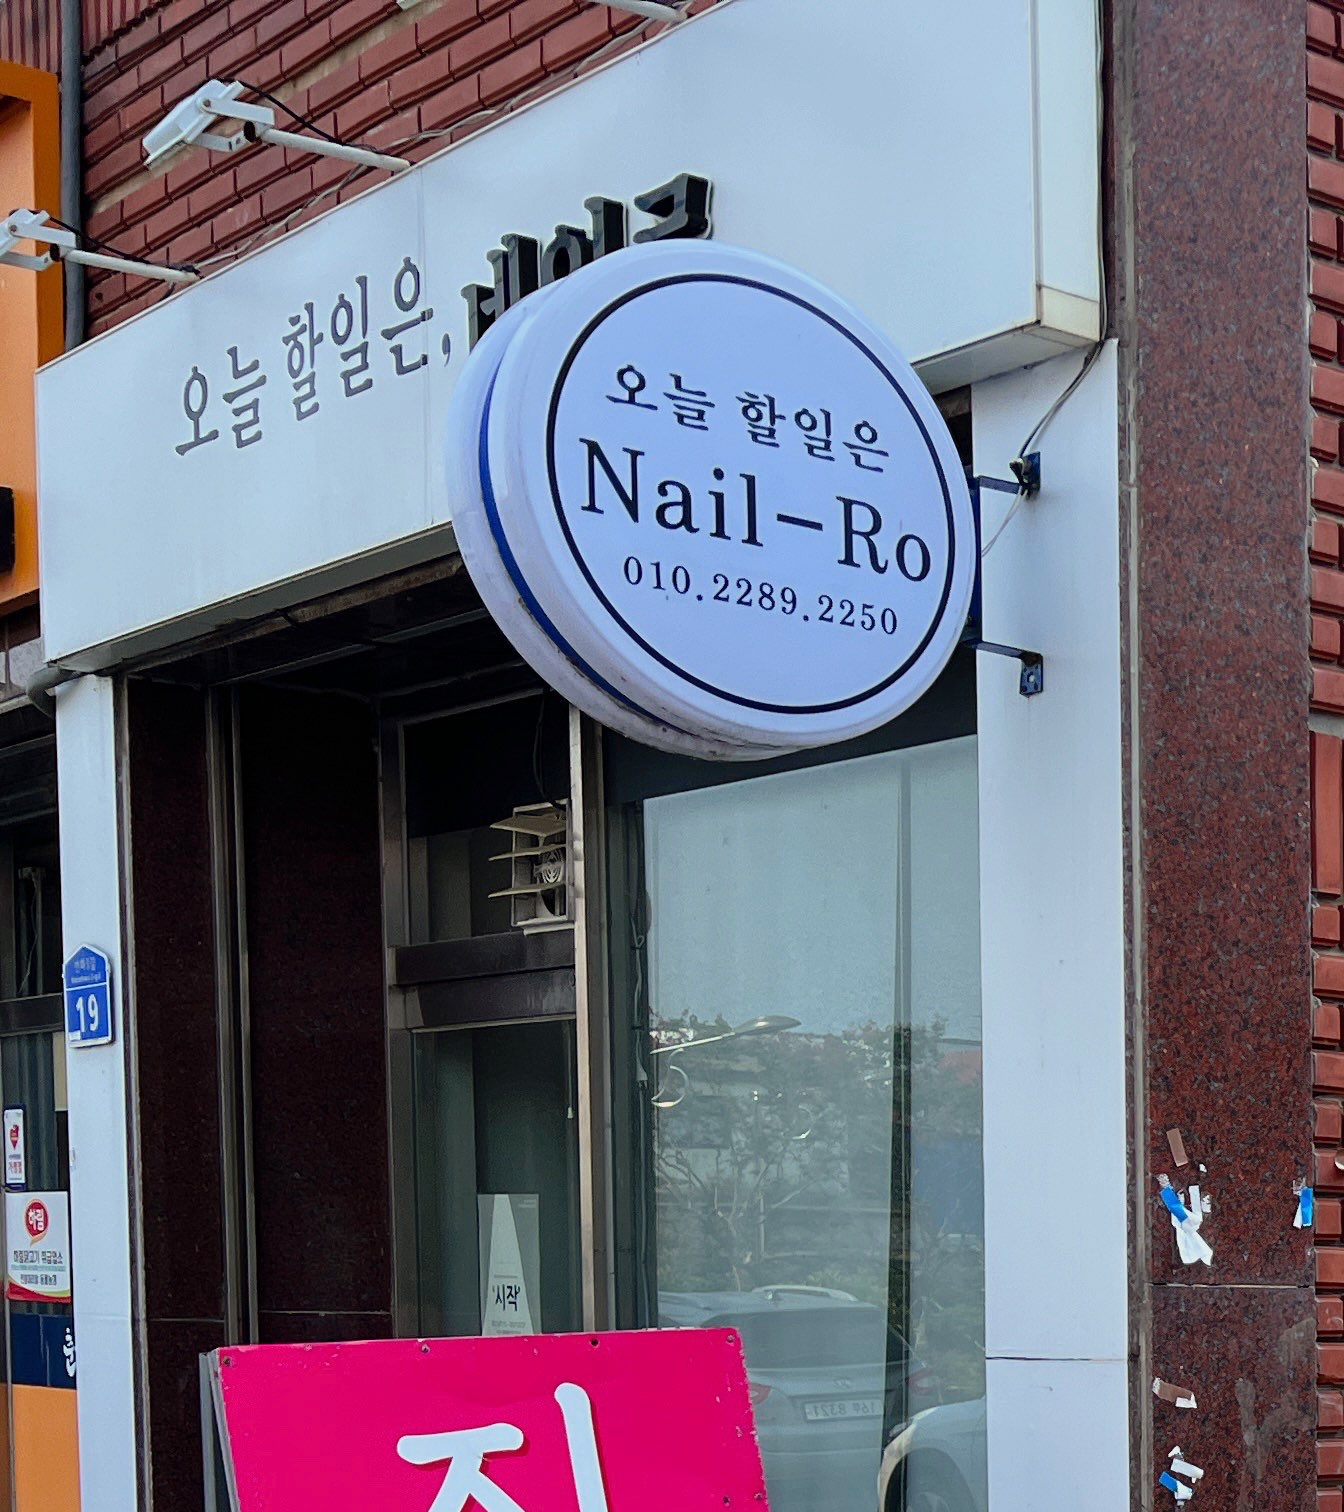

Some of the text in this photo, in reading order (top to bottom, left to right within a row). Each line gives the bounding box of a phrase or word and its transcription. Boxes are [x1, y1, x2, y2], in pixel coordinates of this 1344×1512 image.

[175, 345, 267, 456] 오늘
[605, 364, 889, 473] 오늘 할일은
[579, 437, 931, 582] Nail-Ro
[623, 556, 898, 635] 010.2289.2250
[76, 993, 99, 1032] 19
